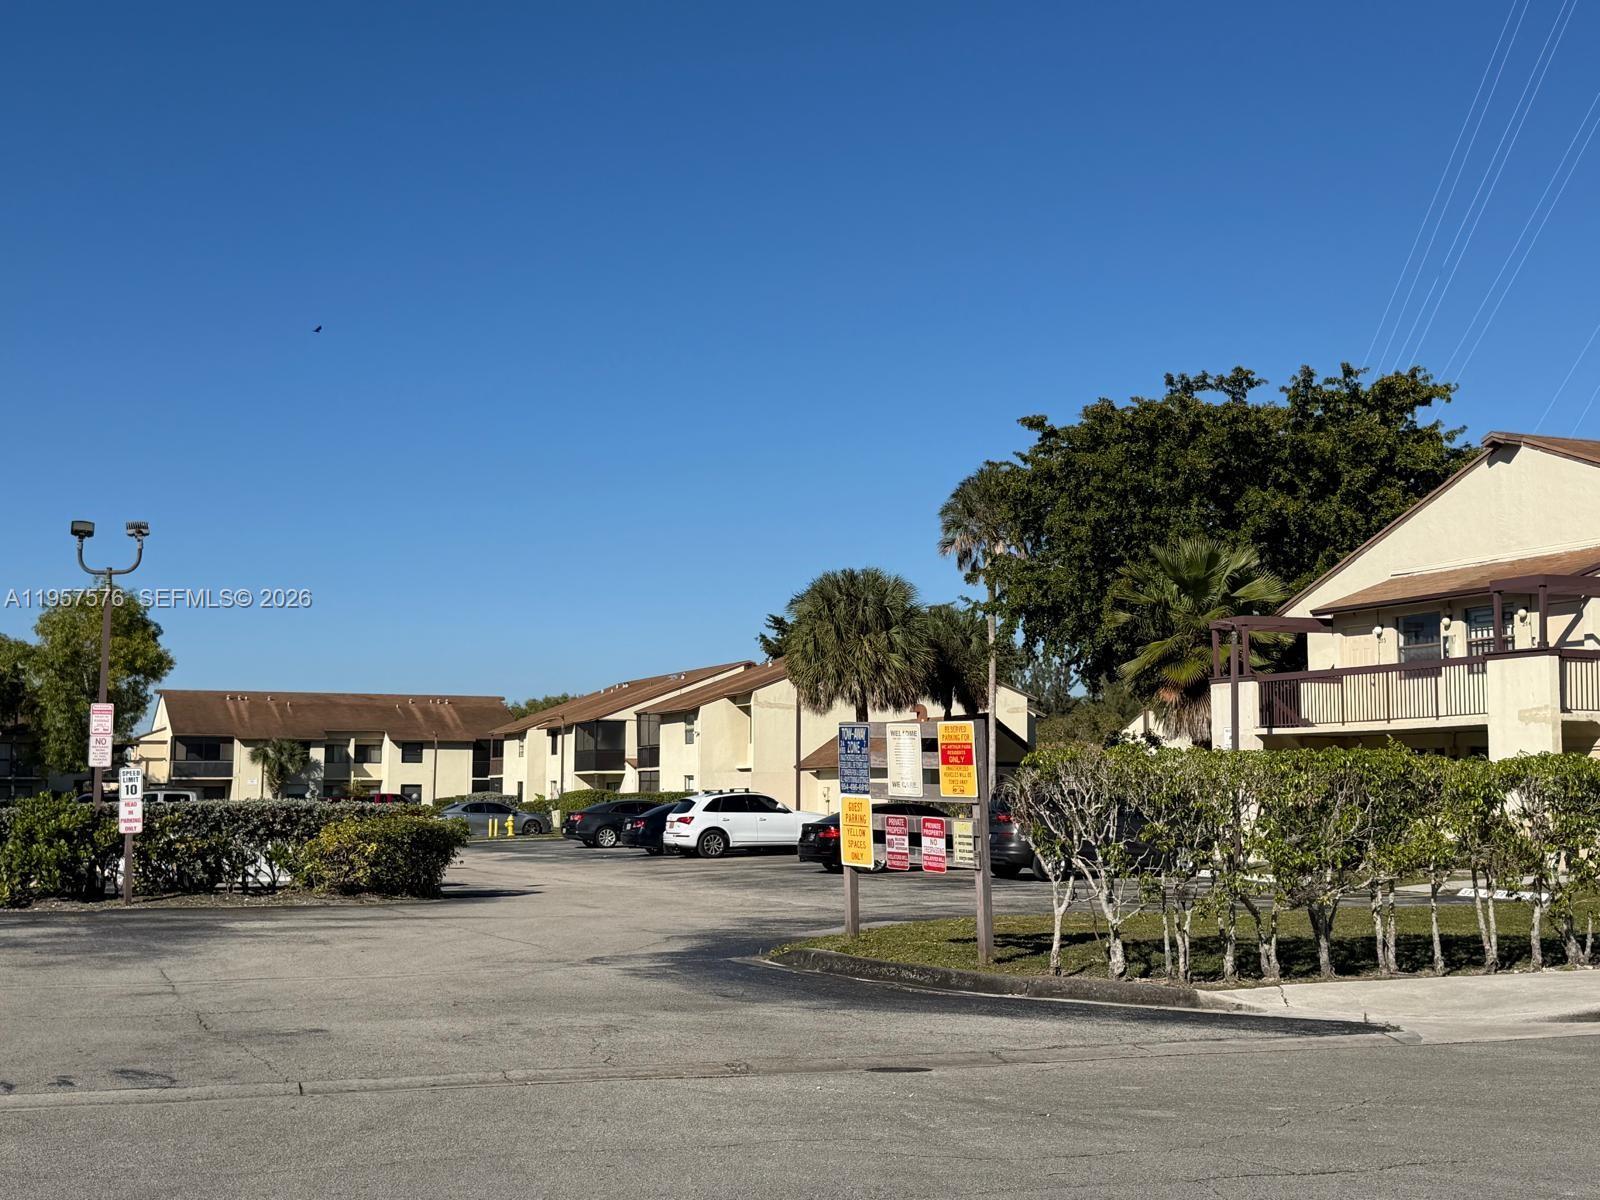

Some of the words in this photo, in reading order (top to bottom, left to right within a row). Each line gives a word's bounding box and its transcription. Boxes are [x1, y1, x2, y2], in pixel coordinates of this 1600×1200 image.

[841, 728, 866, 740] TOW-AWAY
[847, 741, 861, 754] ZONE
[125, 784, 137, 795] 10
[849, 802, 862, 812] GUEST
[845, 813, 866, 824] PARKING
[888, 818, 905, 826] PRIVATE
[887, 826, 907, 835] PROPERTY
[925, 822, 942, 830] PRIVATE
[847, 828, 865, 837] YELLOW
[923, 829, 944, 837] PROPERTY
[847, 840, 866, 849] SPACES
[851, 852, 864, 860] ONLY
